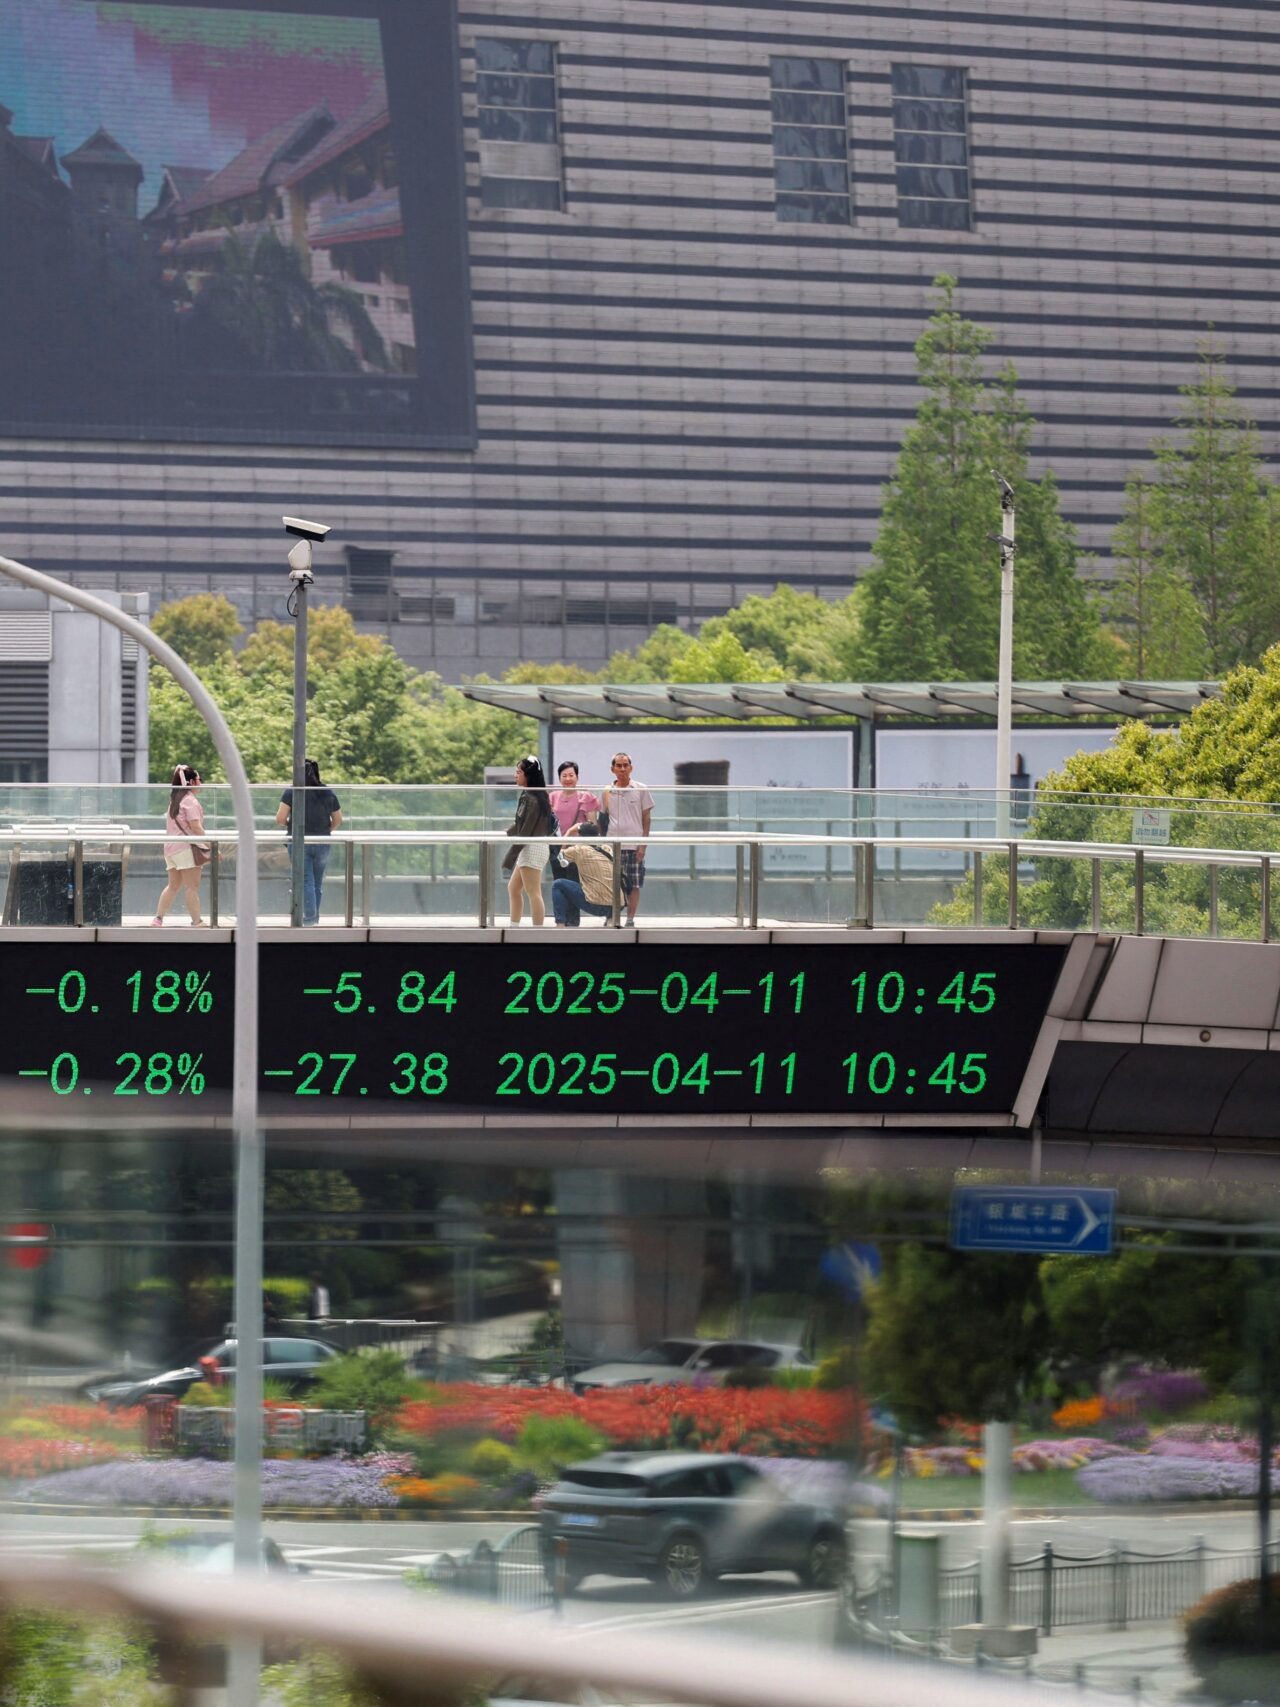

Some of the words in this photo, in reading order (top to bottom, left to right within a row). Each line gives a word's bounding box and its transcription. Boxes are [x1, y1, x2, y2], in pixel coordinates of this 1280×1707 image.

[26, 970, 213, 1013] -0.18%
[303, 970, 458, 1014] -5.84
[504, 971, 805, 1014] 2025-04-11
[851, 971, 997, 1015] 10:45
[20, 1052, 206, 1096] -0.28%
[265, 1052, 449, 1095] -27.38
[496, 1052, 796, 1095] 2025-04-11
[842, 1051, 987, 1095] 10:45
